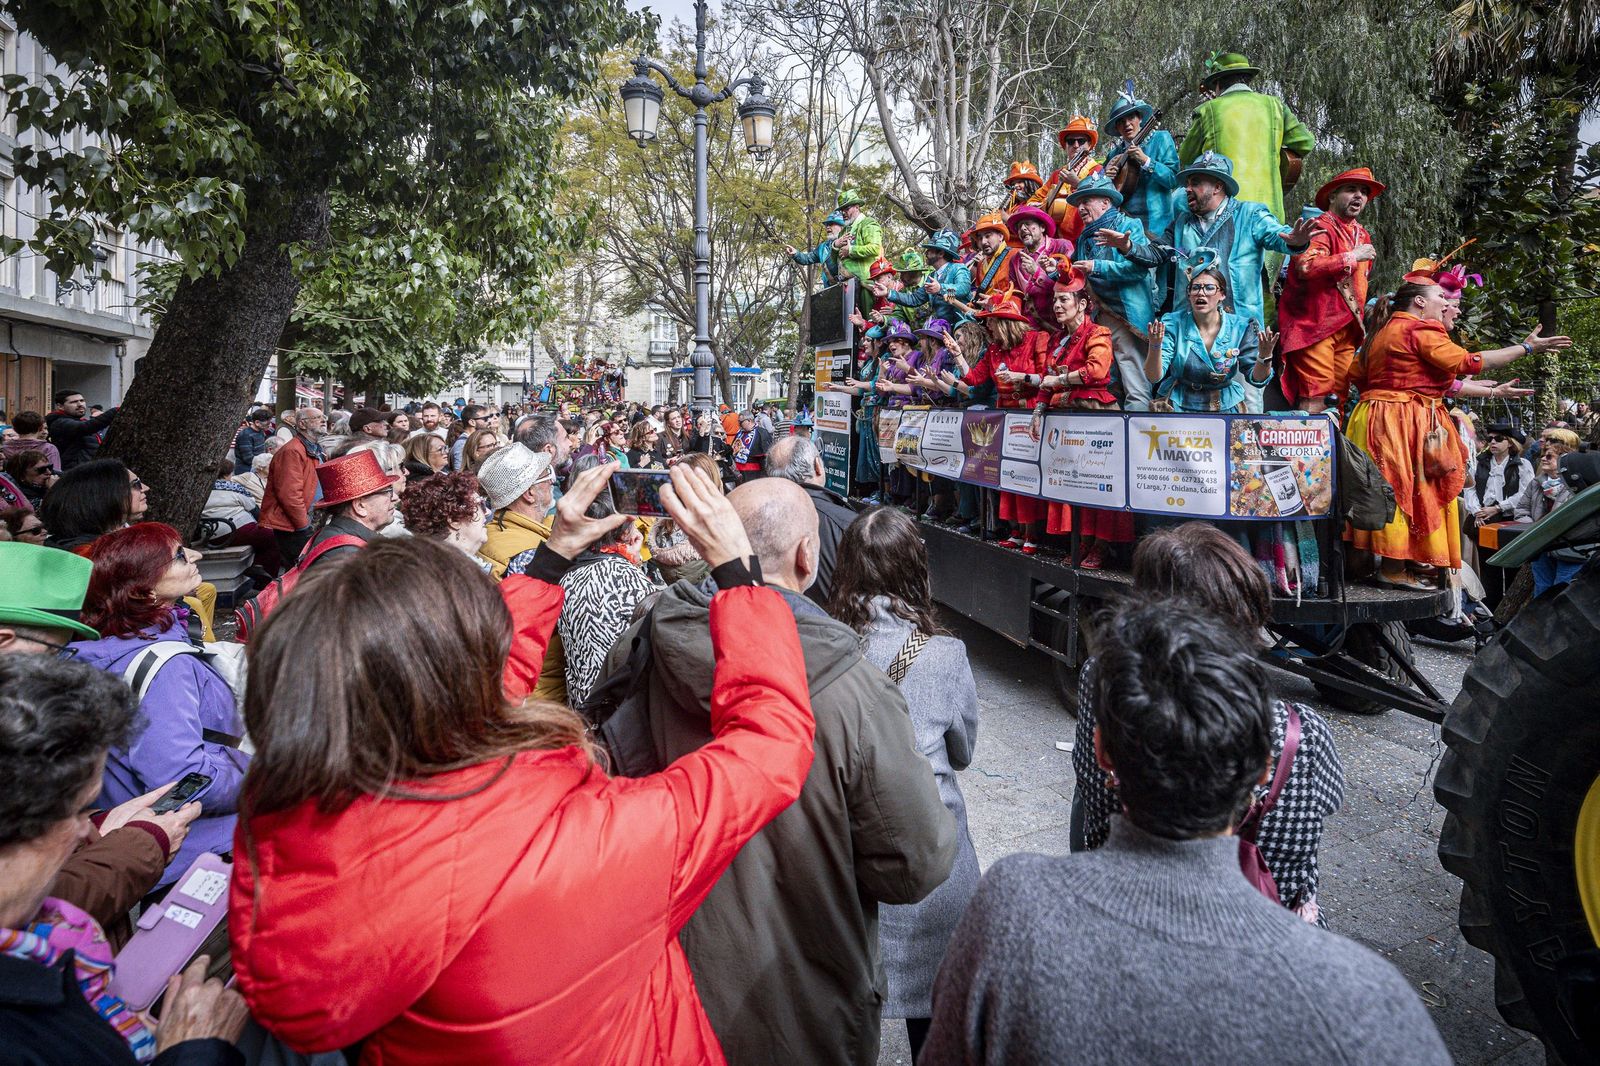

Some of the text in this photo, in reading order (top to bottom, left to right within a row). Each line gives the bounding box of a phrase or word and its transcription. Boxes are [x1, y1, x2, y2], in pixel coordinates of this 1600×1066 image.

[1261, 430, 1320, 444] CARNAVAL
[1168, 437, 1213, 449] PLAZA
[1164, 450, 1213, 462] MAYOR
[1244, 448, 1268, 456] sabe
[1280, 448, 1321, 456] GLORIA
[1136, 466, 1217, 475] www.ortoplazamayor.es
[1144, 483, 1161, 491] Larga,
[1171, 485, 1199, 493] Chiclana,
[1200, 486, 1217, 494] Cádiz
